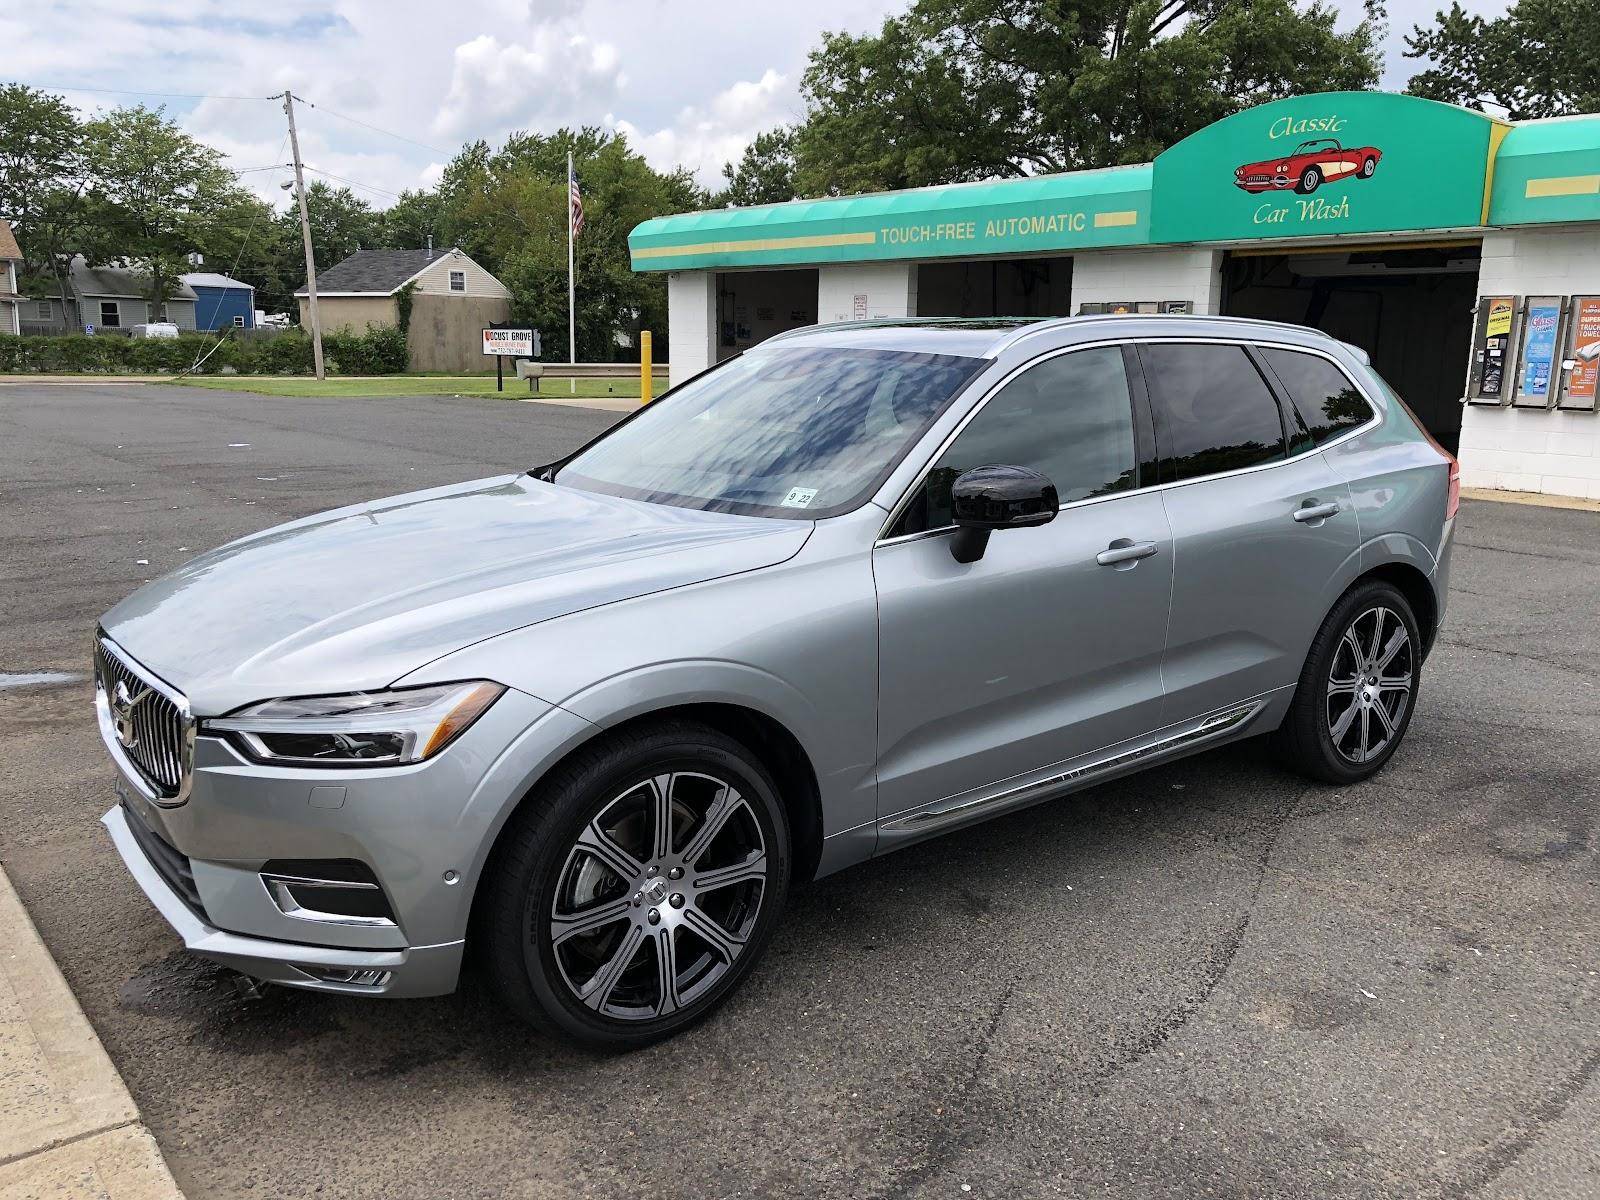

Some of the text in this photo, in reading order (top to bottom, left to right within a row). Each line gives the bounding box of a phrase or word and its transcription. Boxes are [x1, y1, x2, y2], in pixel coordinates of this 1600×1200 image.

[1269, 115, 1348, 139] Classic
[1253, 195, 1350, 225] Car Wash
[880, 212, 1087, 245] TOUCH-FREE AUTOMATIC
[1531, 314, 1557, 329] Glass
[511, 331, 531, 341] GROVE
[788, 493, 811, 503] 9 22
